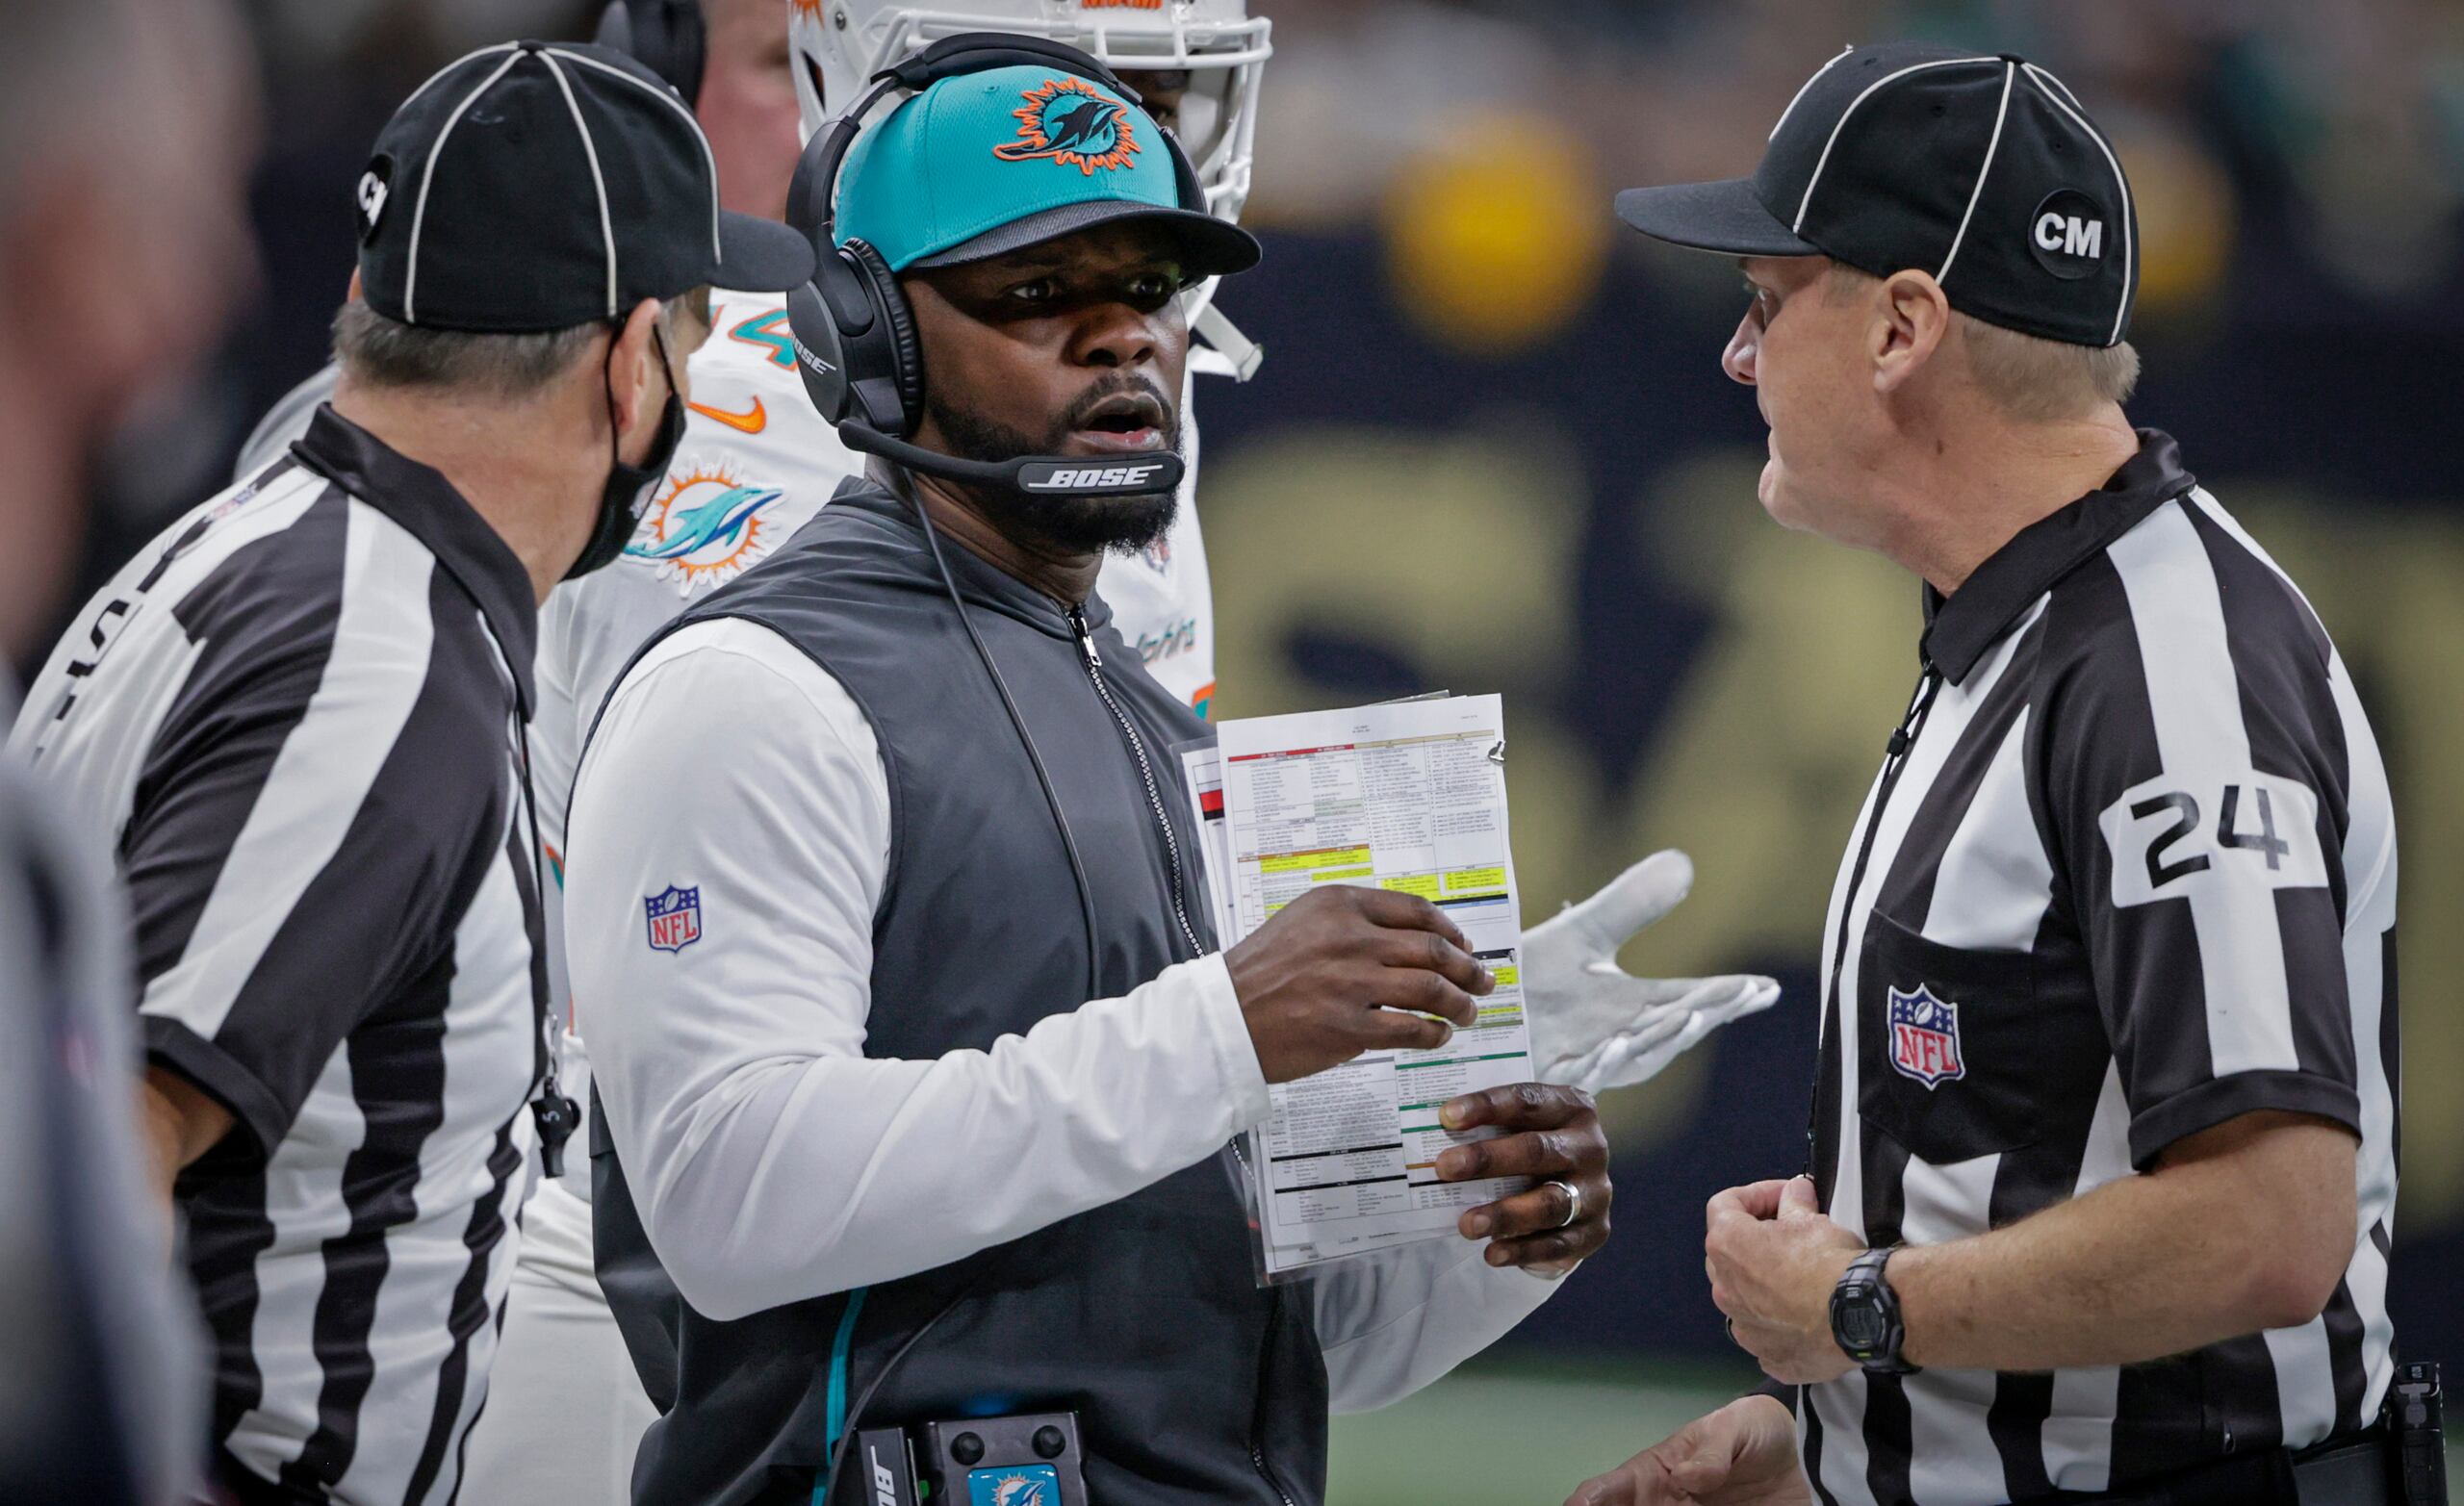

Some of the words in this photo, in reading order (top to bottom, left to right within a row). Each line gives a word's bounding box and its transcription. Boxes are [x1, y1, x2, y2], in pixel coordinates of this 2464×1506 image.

[2034, 212, 2103, 259] CM
[1027, 464, 1163, 488] BOSE
[2130, 784, 2290, 889] 24
[652, 910, 698, 946] NFL
[1896, 1025, 1958, 1076] NFL
